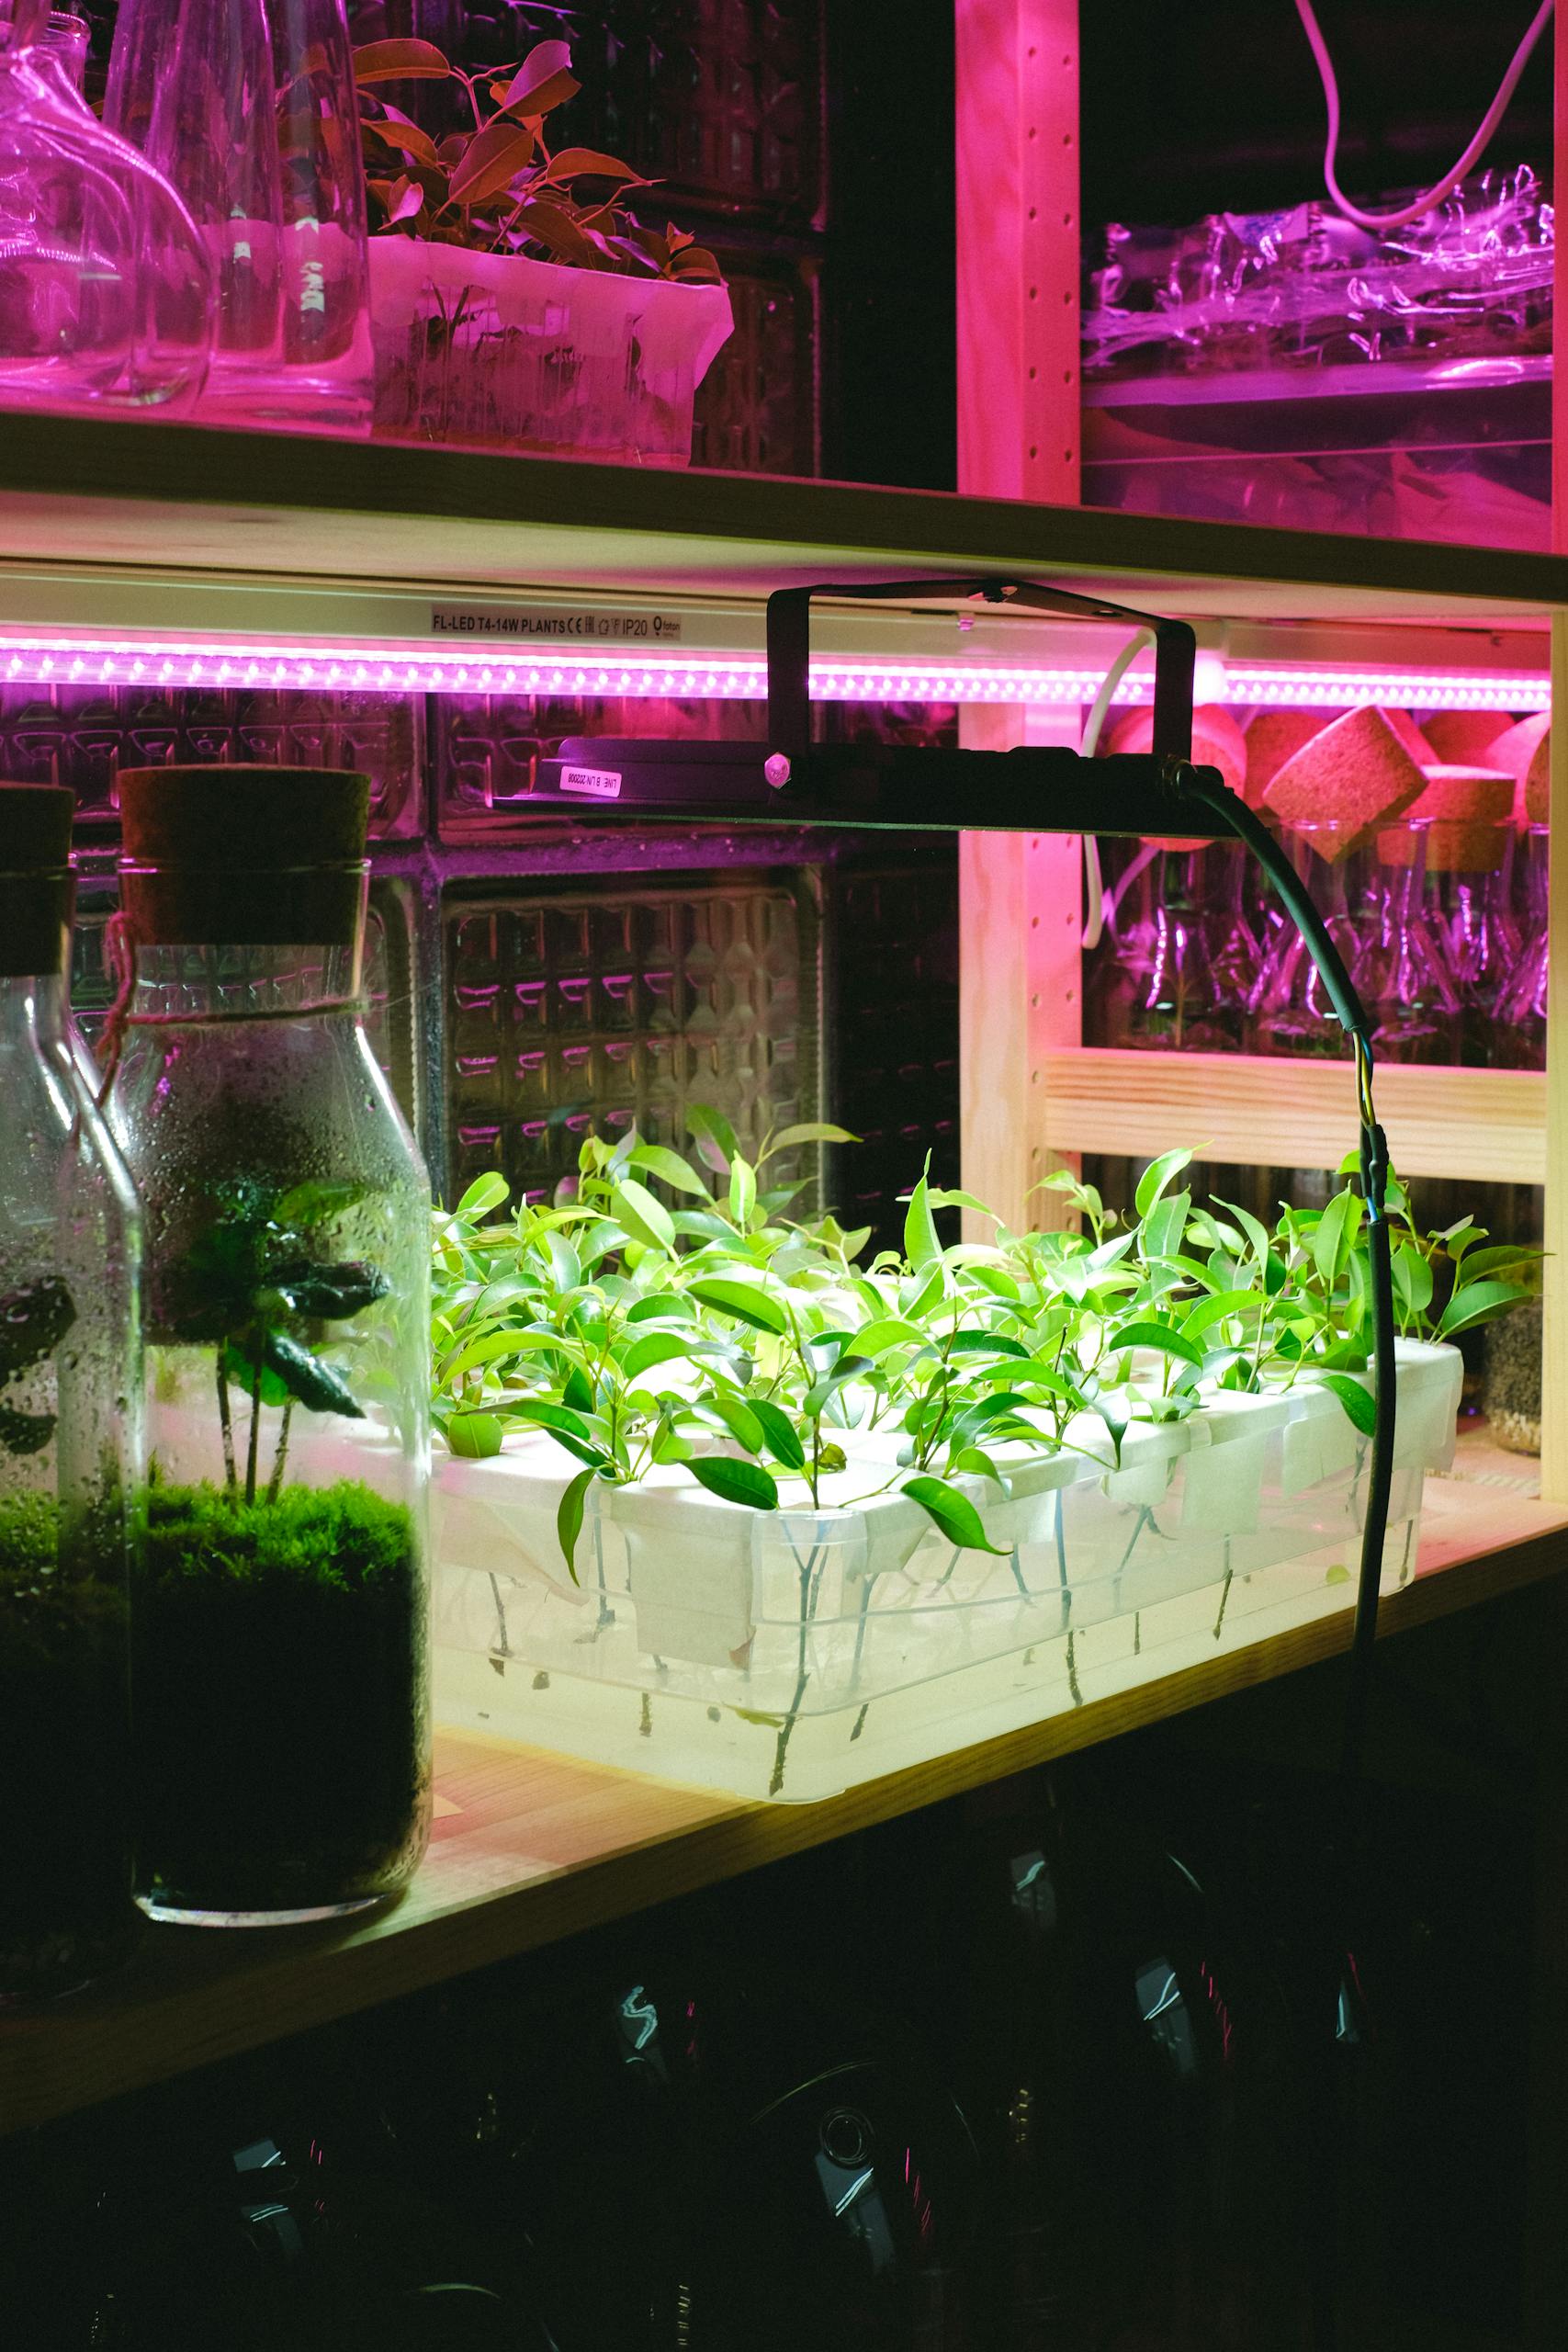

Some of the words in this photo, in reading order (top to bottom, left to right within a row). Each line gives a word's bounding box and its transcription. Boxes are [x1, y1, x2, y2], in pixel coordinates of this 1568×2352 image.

[434, 615, 475, 630] FL-LED
[477, 616, 519, 632] T4-14W
[521, 618, 565, 634] PLANTS
[623, 617, 648, 637] IP20
